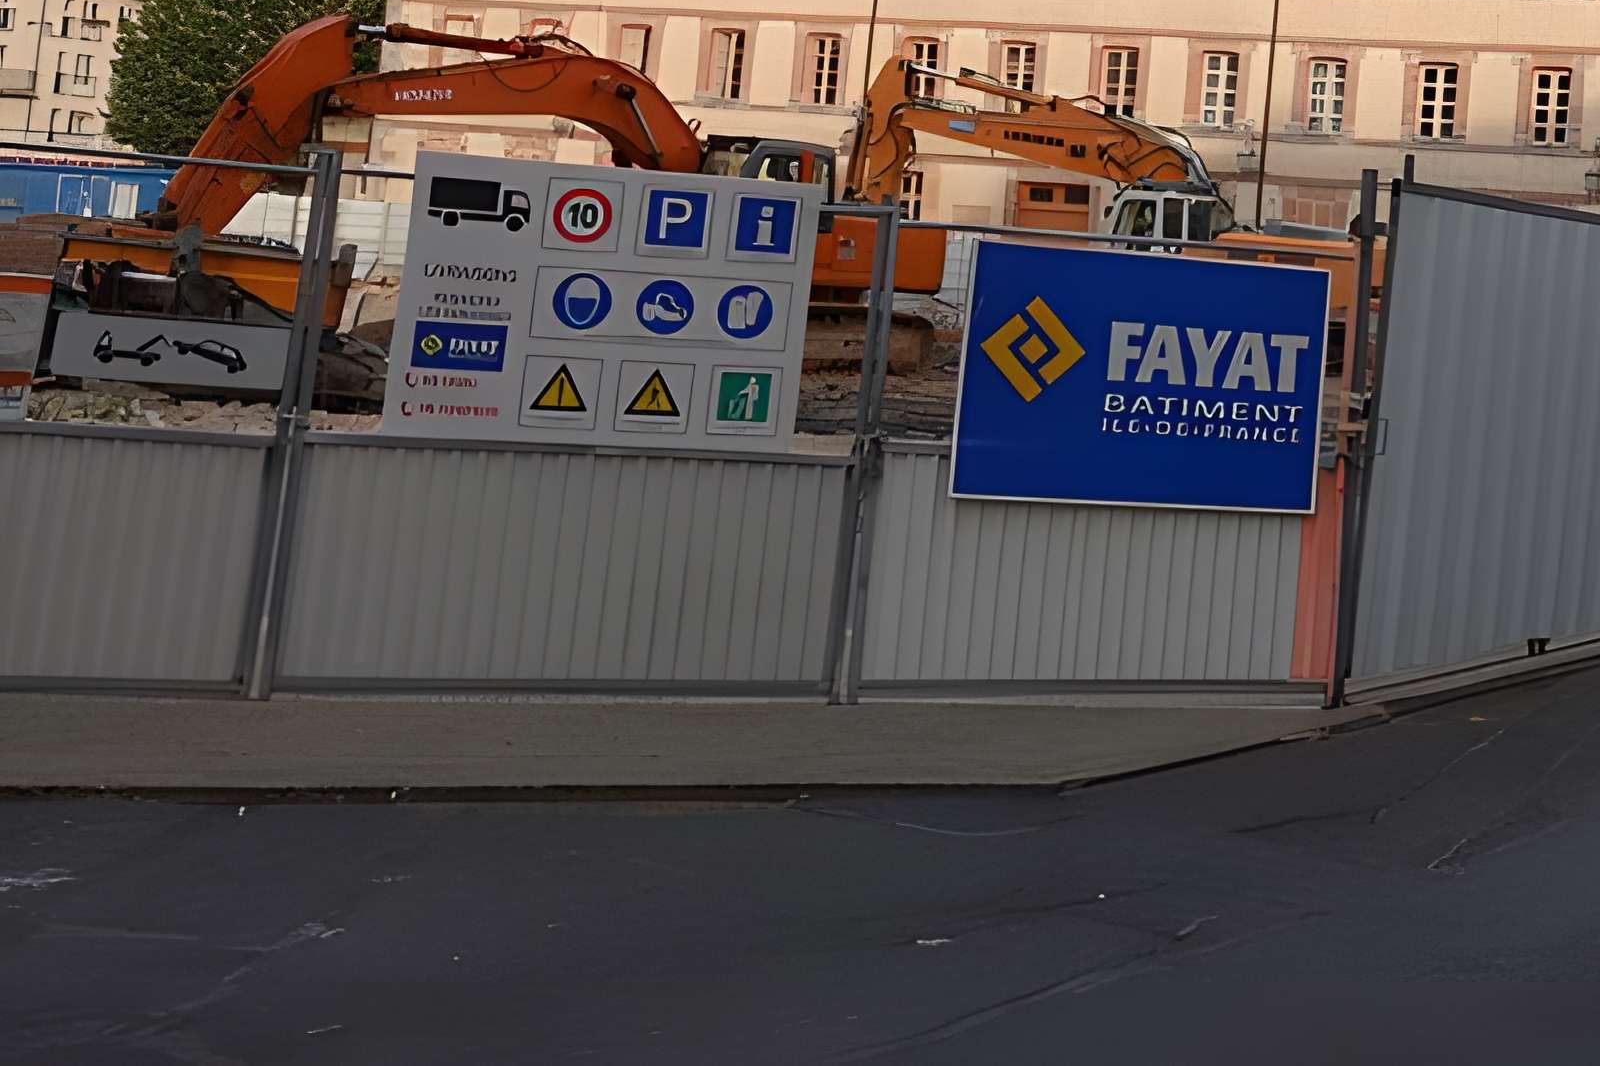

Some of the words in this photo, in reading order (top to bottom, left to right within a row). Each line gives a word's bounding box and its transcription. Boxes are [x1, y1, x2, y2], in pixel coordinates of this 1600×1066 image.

[568, 201, 599, 229] 10
[658, 197, 693, 239] P
[1107, 321, 1310, 394] FAYAT
[1104, 393, 1303, 423] BATIMENT
